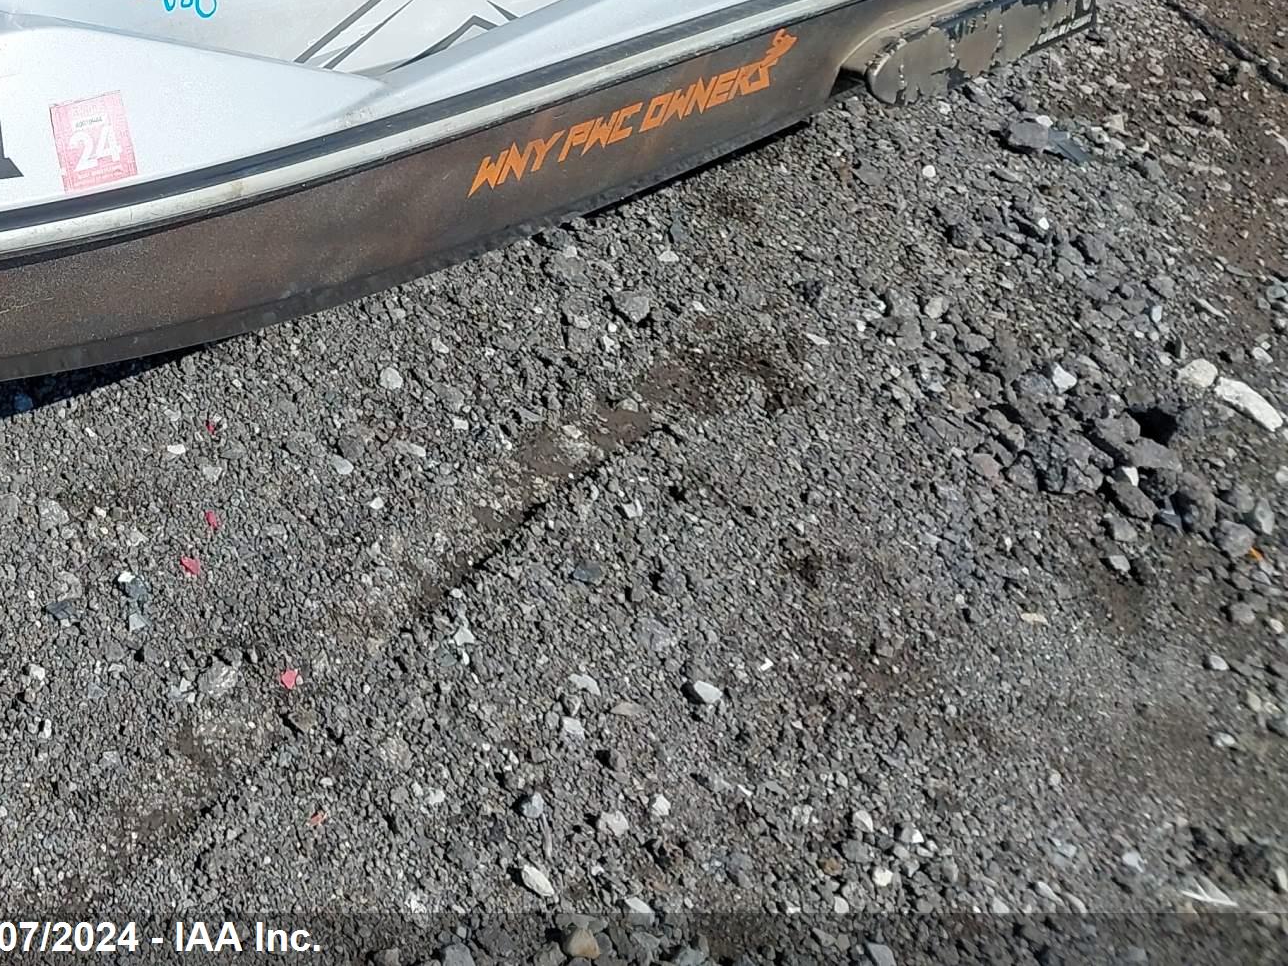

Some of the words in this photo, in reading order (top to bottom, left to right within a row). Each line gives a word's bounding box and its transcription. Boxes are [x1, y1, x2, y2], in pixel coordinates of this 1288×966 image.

[68, 124, 122, 171] 24
[467, 128, 566, 200] WNY
[557, 101, 644, 163] PWC
[638, 56, 779, 133] OWNERS
